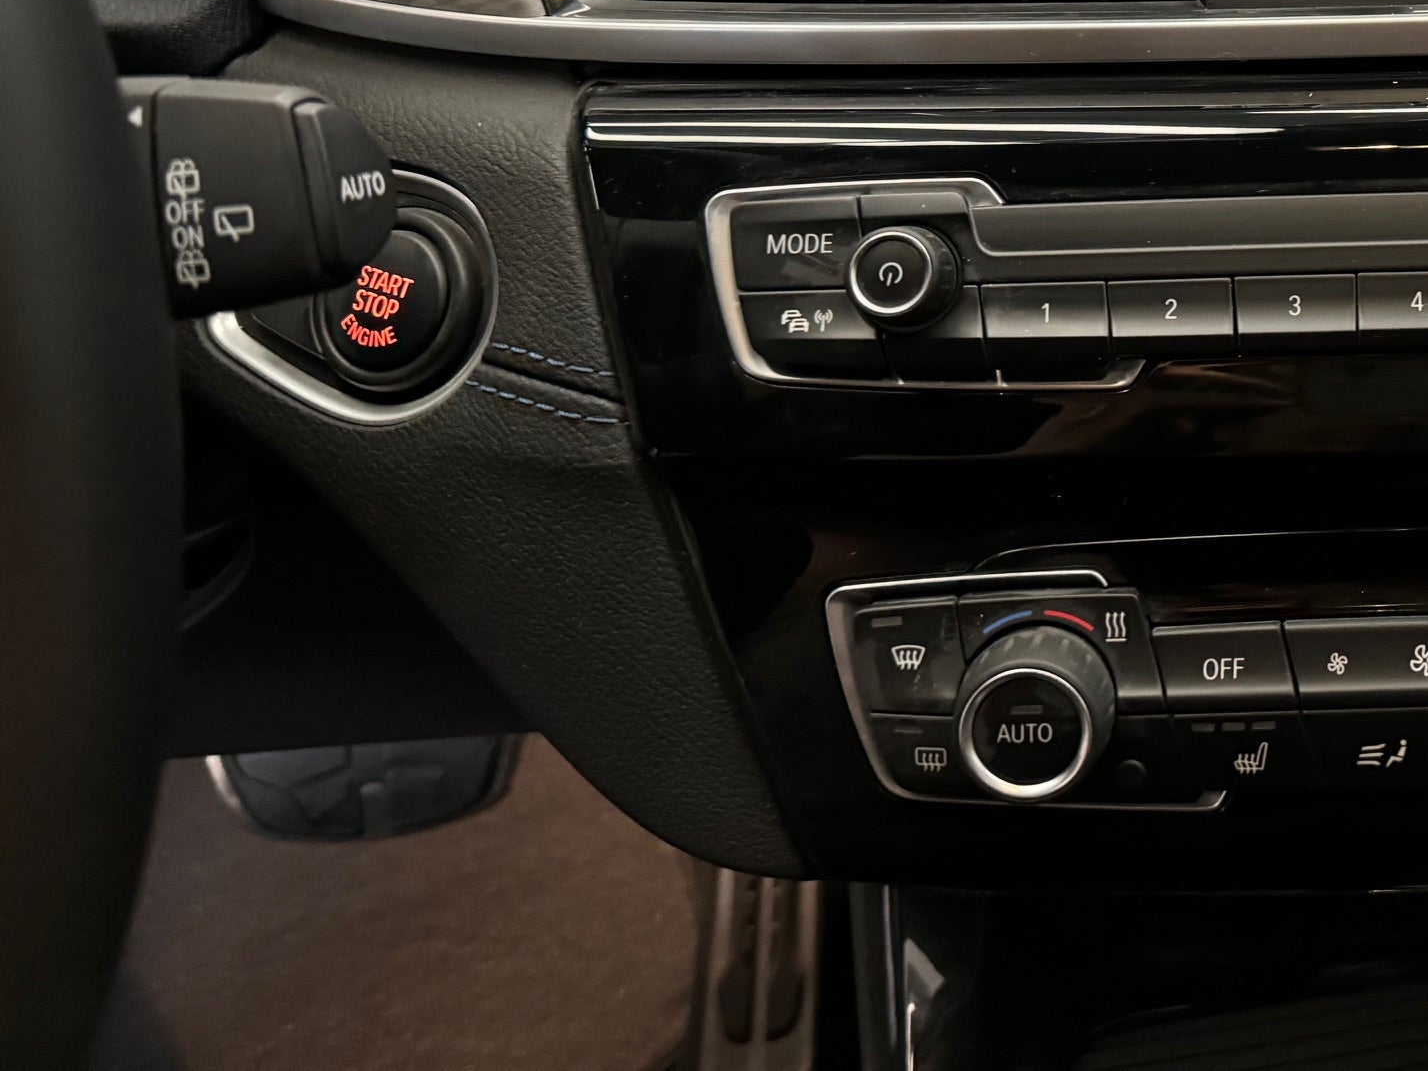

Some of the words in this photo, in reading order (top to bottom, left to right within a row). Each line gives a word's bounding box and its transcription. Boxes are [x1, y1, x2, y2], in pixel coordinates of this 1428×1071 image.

[341, 171, 386, 202] AUTO
[165, 199, 205, 225] OFF
[172, 225, 204, 250] ON
[767, 233, 833, 255] MODE
[357, 265, 414, 298] START
[352, 289, 398, 320] STOP
[1041, 303, 1051, 323] 1
[1164, 298, 1178, 320] 2
[1288, 294, 1301, 316] 3
[1411, 292, 1424, 312] 4
[340, 313, 397, 347] ENGINE
[1202, 657, 1245, 681] OFF
[997, 722, 1053, 744] AUTO
